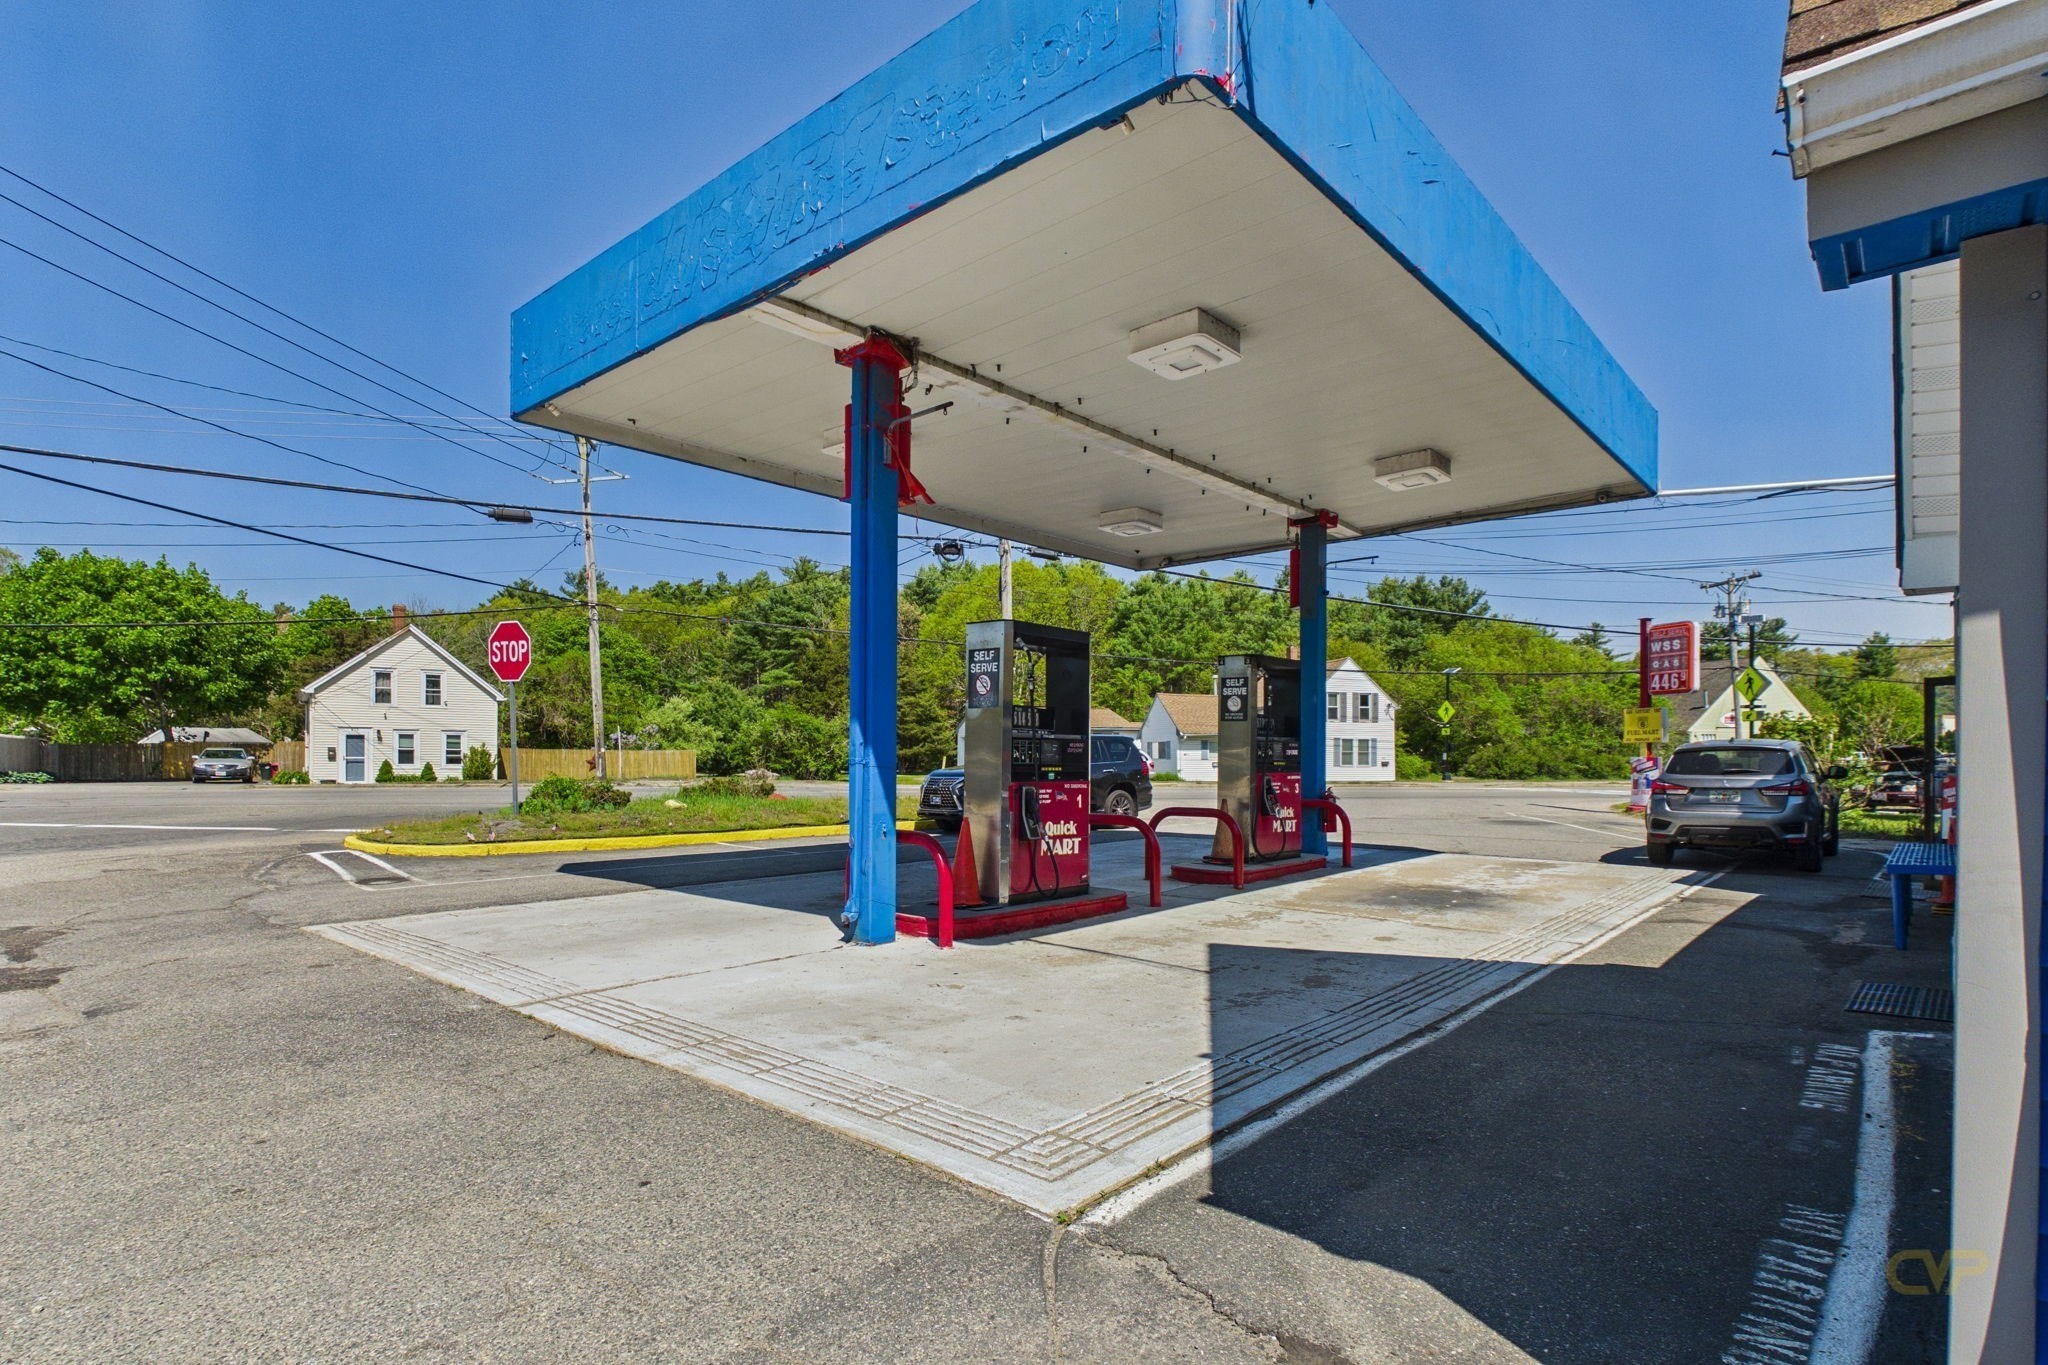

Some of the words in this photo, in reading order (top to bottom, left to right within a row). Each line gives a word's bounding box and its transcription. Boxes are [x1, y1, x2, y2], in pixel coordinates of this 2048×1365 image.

[492, 640, 528, 663] STOP
[1651, 639, 1681, 652] WSS
[973, 650, 995, 661] SELF
[970, 662, 998, 673] SERVE
[1225, 678, 1245, 687] SELF
[1651, 673, 1679, 691] 446
[1222, 687, 1247, 696] SERVE
[1294, 782, 1299, 794] 3
[1076, 794, 1082, 809] 1
[1045, 820, 1078, 836] Quick
[1040, 837, 1081, 857] MART
